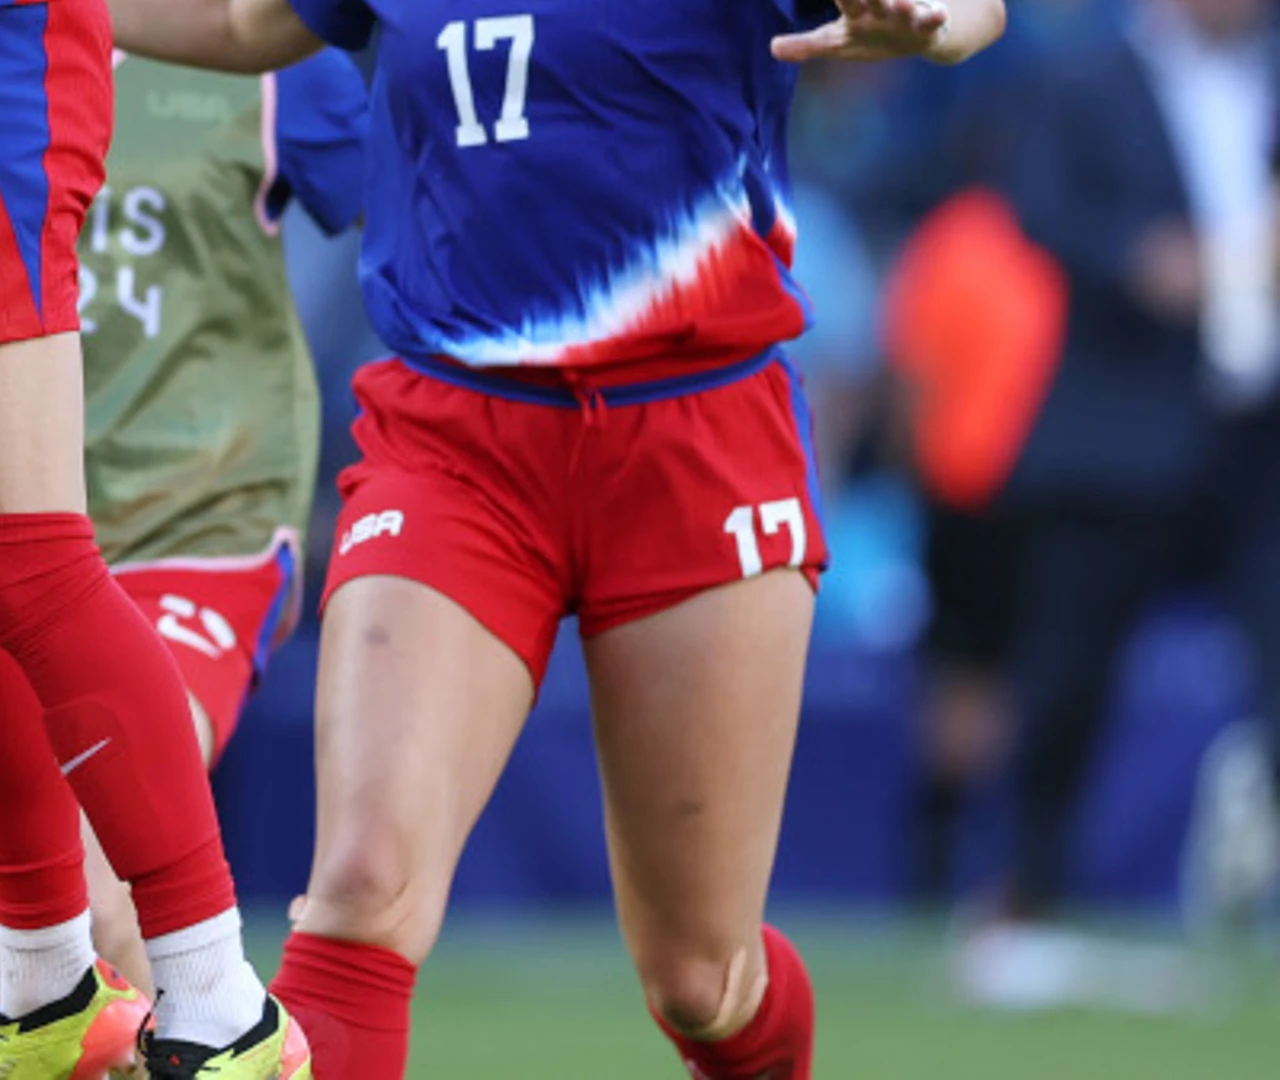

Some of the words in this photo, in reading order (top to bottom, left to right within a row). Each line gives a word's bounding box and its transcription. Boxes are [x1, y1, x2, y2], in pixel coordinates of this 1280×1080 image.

[436, 14, 534, 148] 17
[339, 509, 405, 556] USA
[724, 497, 807, 580] 17
